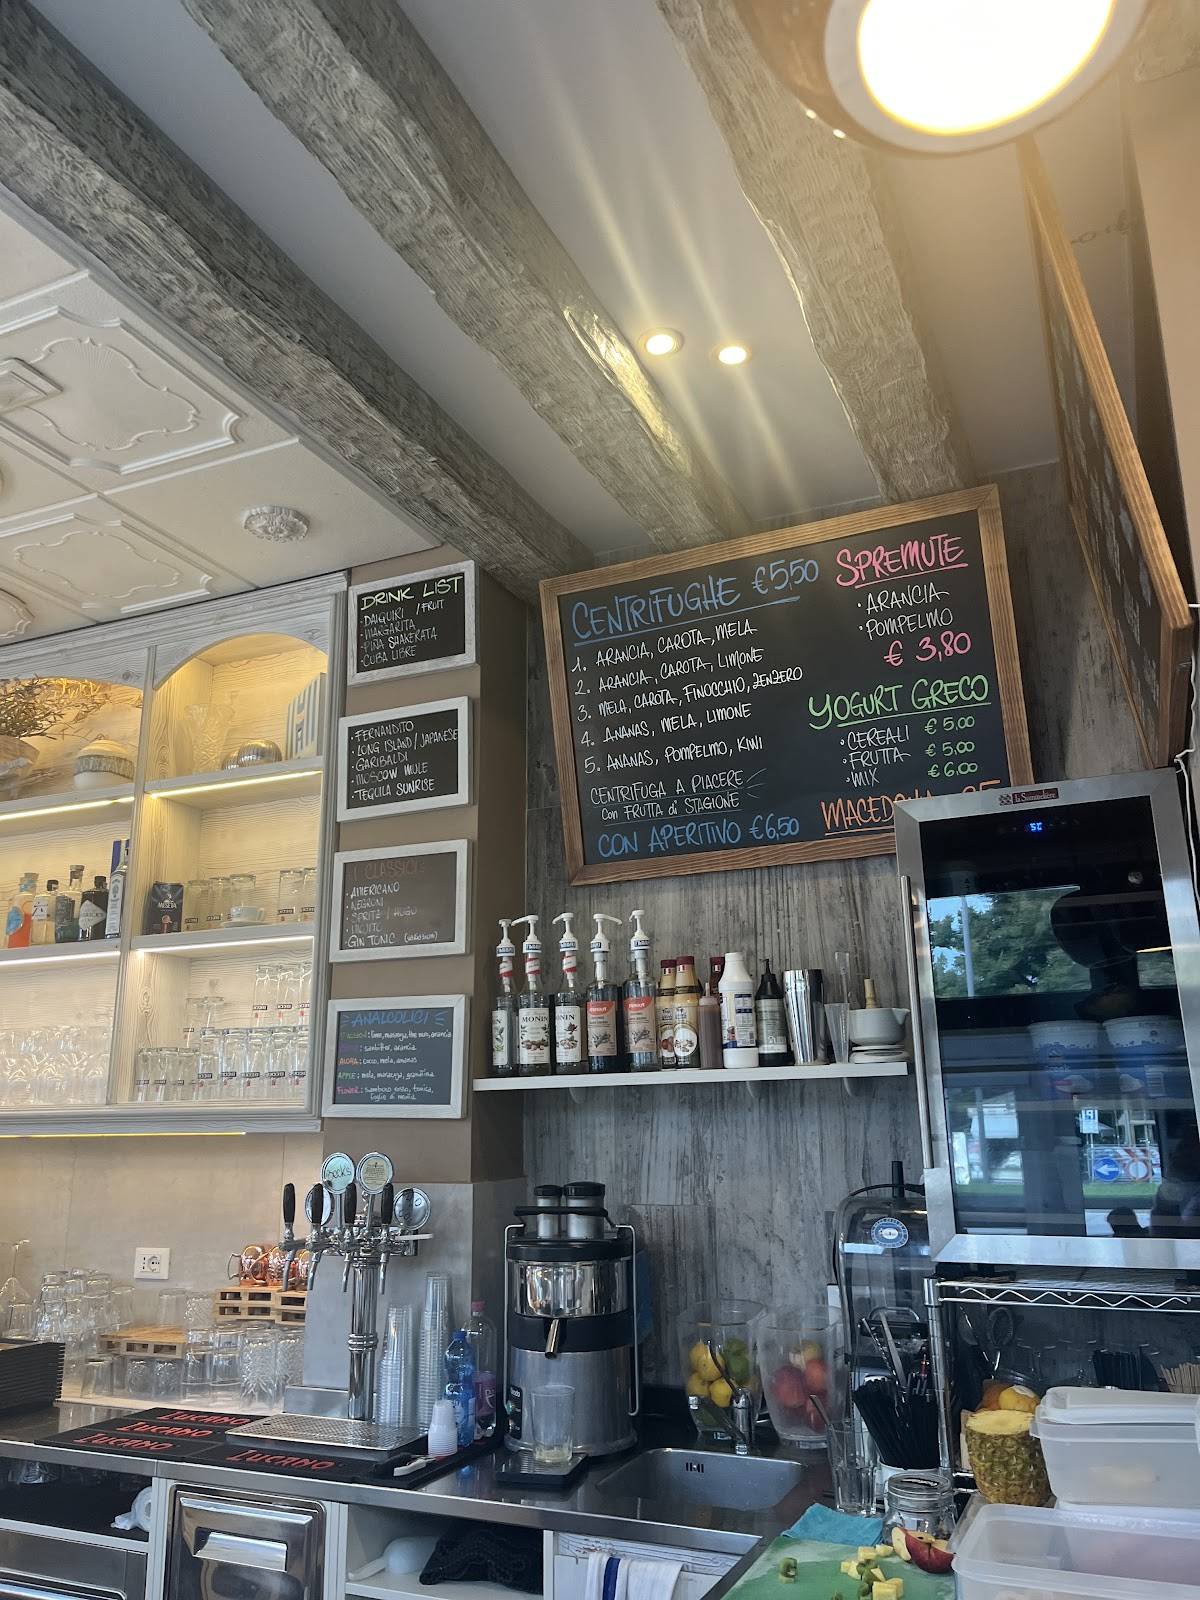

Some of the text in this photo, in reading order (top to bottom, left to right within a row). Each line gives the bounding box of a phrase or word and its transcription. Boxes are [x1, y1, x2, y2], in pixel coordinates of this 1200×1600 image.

[836, 533, 964, 587] SPREMUTE
[361, 576, 463, 611] DRINK LIST
[572, 559, 819, 639] CENTRIFUGHE €5,50
[866, 582, 950, 615] ARANCIA
[865, 608, 953, 640] POMPELMO
[363, 645, 417, 667] CUBA LIBRE
[572, 619, 758, 672] 1. ARANCIA, CAROTA, MELA
[915, 630, 972, 662] 3,80
[575, 647, 765, 695] 2. ARANCIA, CAROTA, LIMONE
[577, 705, 592, 721] 3.
[598, 700, 632, 717] MELA,
[634, 690, 682, 709] CAROTA,
[683, 677, 750, 703] FINOCCHIO,
[808, 674, 989, 730] YOGURT GRECO
[355, 720, 414, 741] FERNANDITO
[581, 702, 752, 746] 4. ANANAS, MELA, LIMONE
[847, 725, 910, 750] CEREALI
[357, 741, 380, 756] LONG
[384, 737, 412, 752] ISLAND
[420, 728, 458, 748] JAPANESE
[584, 736, 763, 774] 5. ANANAS, POMPELMO, KIWI
[849, 747, 911, 769] FRUTTA
[355, 751, 408, 771] GARIBALDI
[396, 778, 435, 796] SUNRISE
[590, 770, 743, 805] CENTRIFUGA A PIACERE
[849, 767, 880, 788] MIX
[623, 802, 664, 820] FRUTTA
[685, 792, 740, 814] STAGIONE
[598, 813, 799, 858] CON APERITIVO €6,50
[351, 882, 400, 899] AMERICANO
[347, 934, 365, 948] GIN
